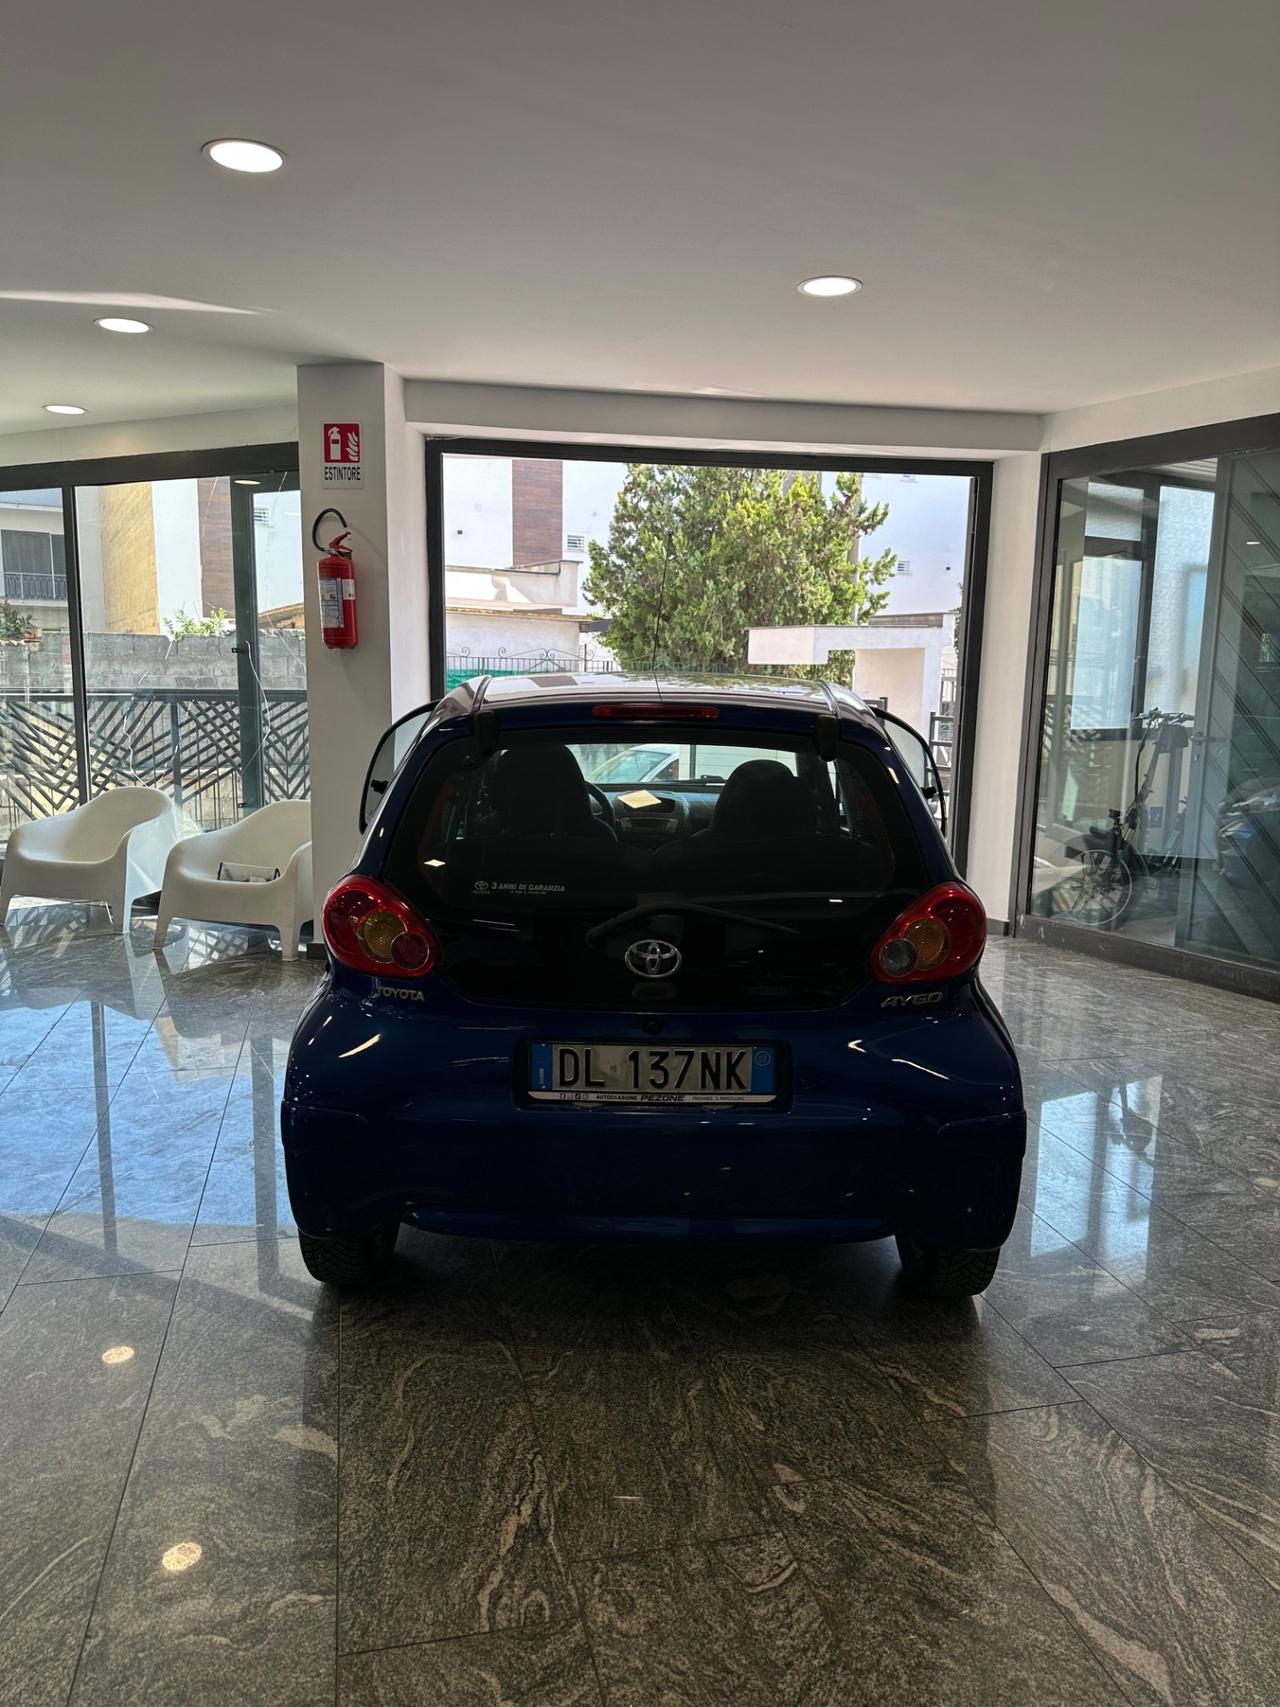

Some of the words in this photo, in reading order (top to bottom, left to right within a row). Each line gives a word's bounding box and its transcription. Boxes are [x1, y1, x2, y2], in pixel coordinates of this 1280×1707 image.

[324, 466, 361, 480] ESTINTORE
[491, 881, 498, 890] 3
[528, 883, 566, 892] GARANZIA
[376, 986, 425, 1001] TOYOTA
[880, 991, 944, 1008] AYGO
[559, 1047, 605, 1088] DL
[628, 1049, 747, 1090] 137NK
[640, 1093, 686, 1102] PEZONE
